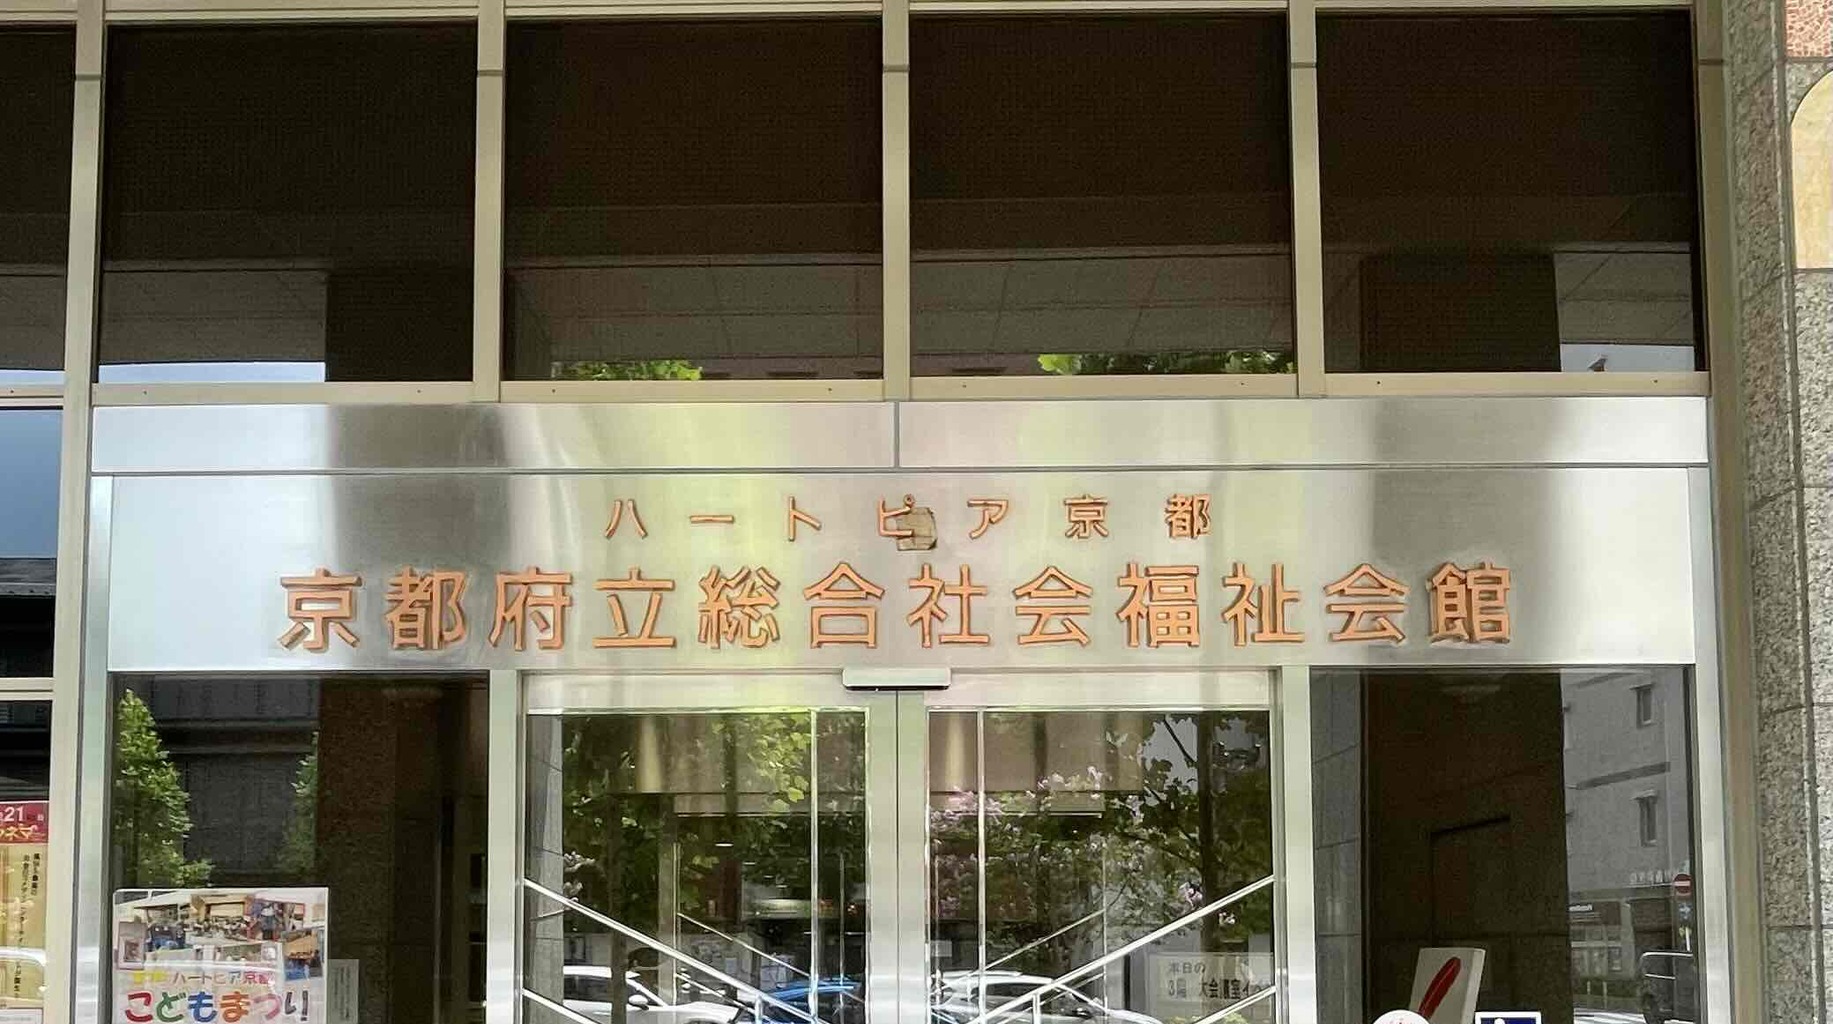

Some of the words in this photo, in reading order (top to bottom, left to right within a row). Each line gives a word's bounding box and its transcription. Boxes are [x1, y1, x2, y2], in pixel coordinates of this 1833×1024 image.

[604, 493, 1212, 541] ハートピア京都
[277, 562, 1512, 650] 京都府立総合社会福祉会館
